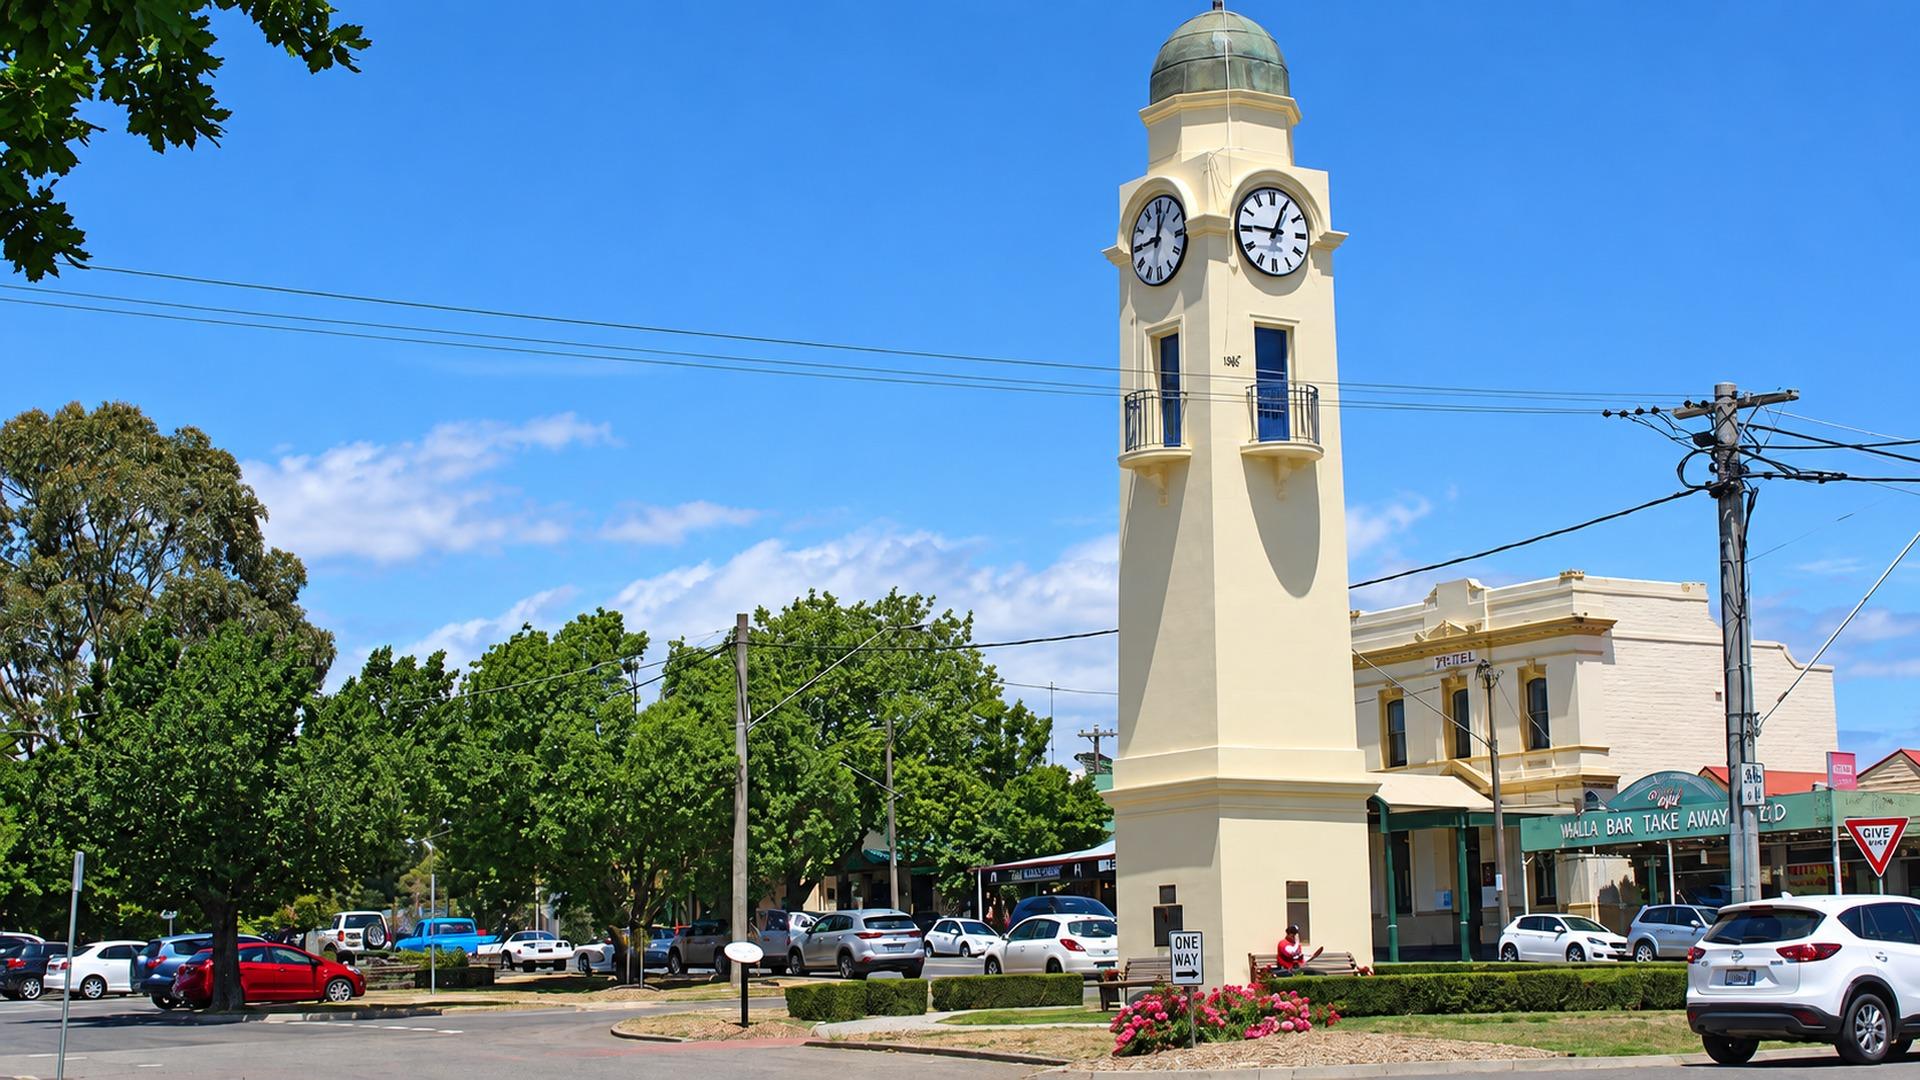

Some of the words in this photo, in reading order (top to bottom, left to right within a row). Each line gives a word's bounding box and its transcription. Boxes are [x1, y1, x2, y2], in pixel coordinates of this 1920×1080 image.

[1606, 816, 1634, 836] BAR
[1643, 812, 1680, 832] TAKE
[1687, 808, 1729, 828] AWAY
[1863, 827, 1890, 838] GIVE
[1175, 936, 1199, 950] ONE
[1174, 953, 1199, 966] WAY
